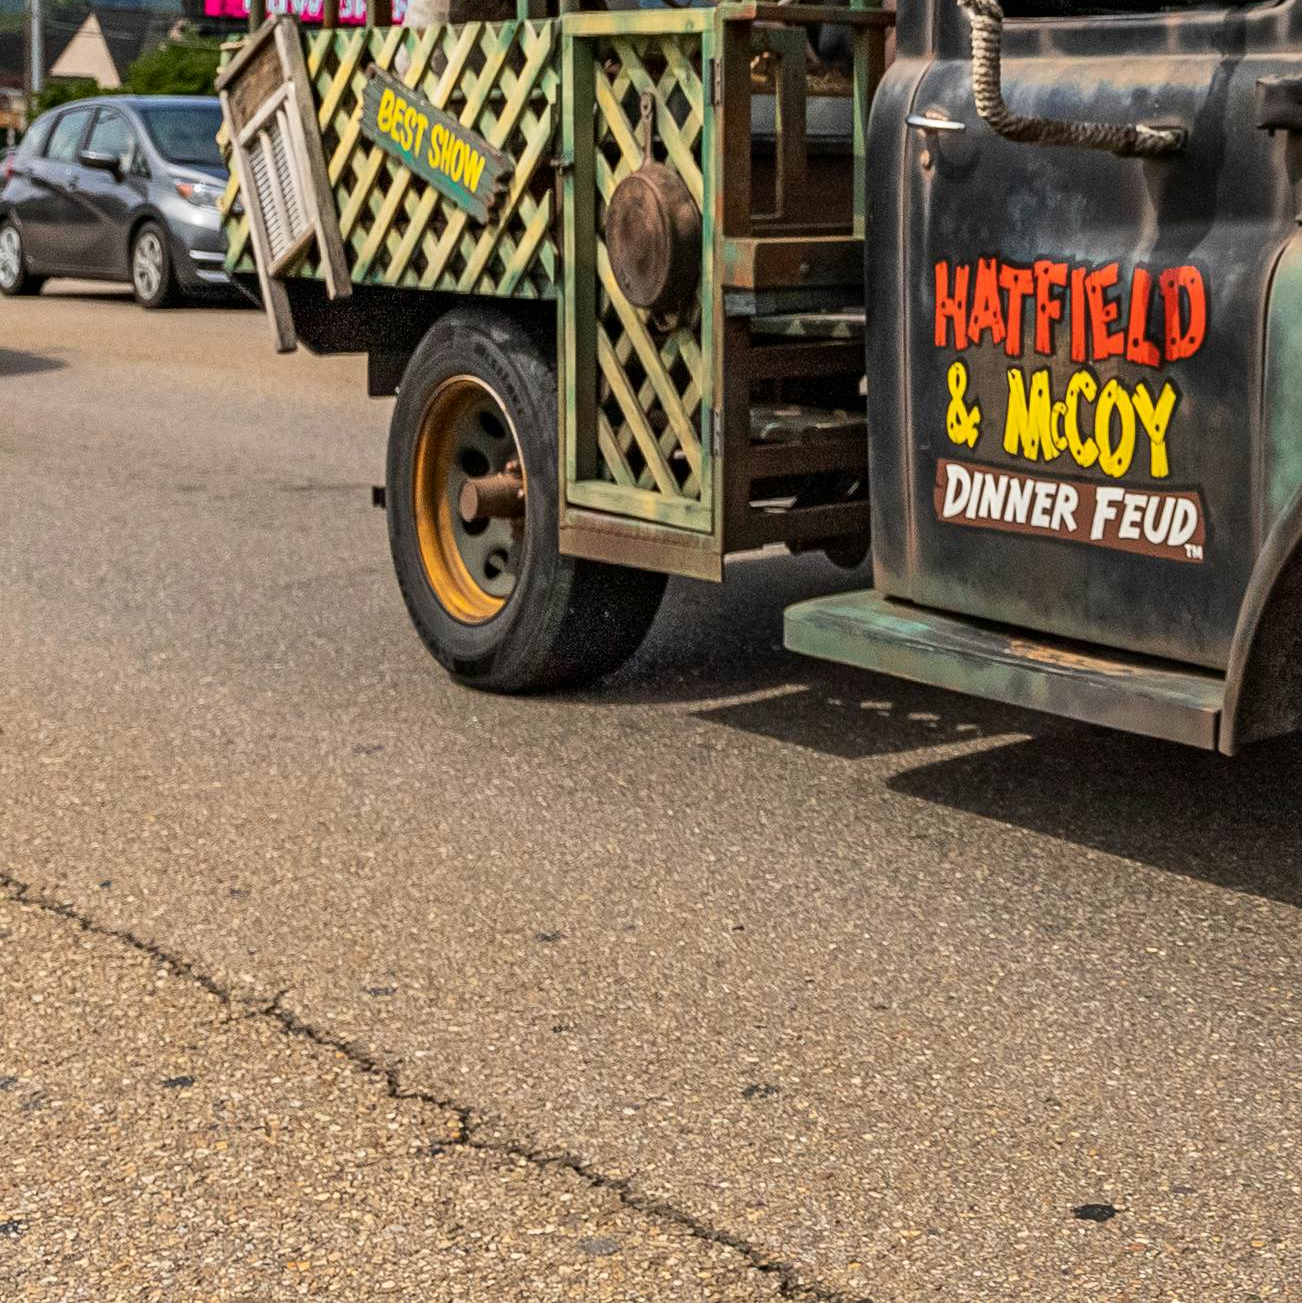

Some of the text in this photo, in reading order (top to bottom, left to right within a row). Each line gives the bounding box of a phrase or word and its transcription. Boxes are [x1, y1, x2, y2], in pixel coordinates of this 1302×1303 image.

[377, 88, 486, 193] BEST SHOW
[934, 256, 1207, 367] HATFIELD
[946, 361, 982, 448] &
[943, 464, 1079, 532] DINNER
[1090, 486, 1198, 546] FEUD
